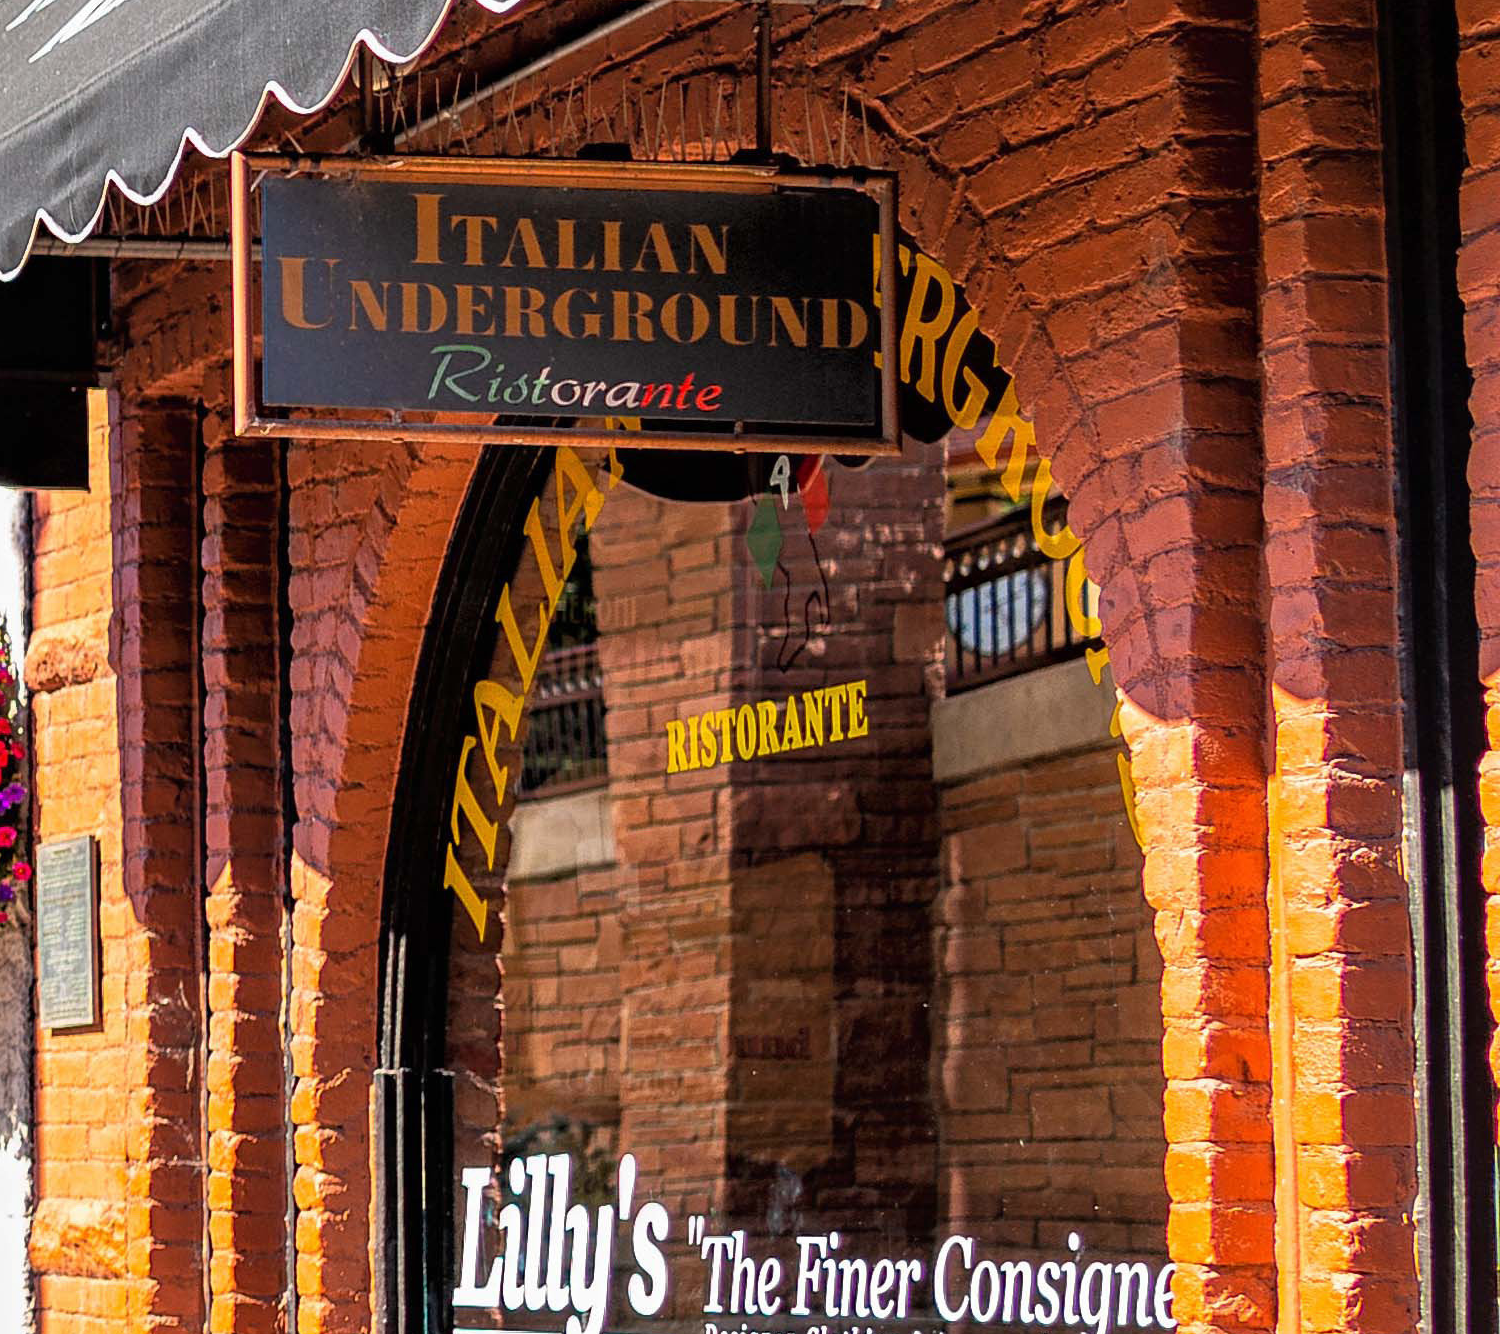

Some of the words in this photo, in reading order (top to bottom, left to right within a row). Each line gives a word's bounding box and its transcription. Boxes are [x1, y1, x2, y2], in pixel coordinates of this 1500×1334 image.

[411, 192, 730, 275] ITALIAN
[278, 256, 869, 349] UNDERGROUND
[427, 344, 723, 412] Ristorante
[443, 416, 642, 943] ITALIA
[666, 680, 868, 774] RISTORANTE
[790, 1231, 922, 1318] Finer
